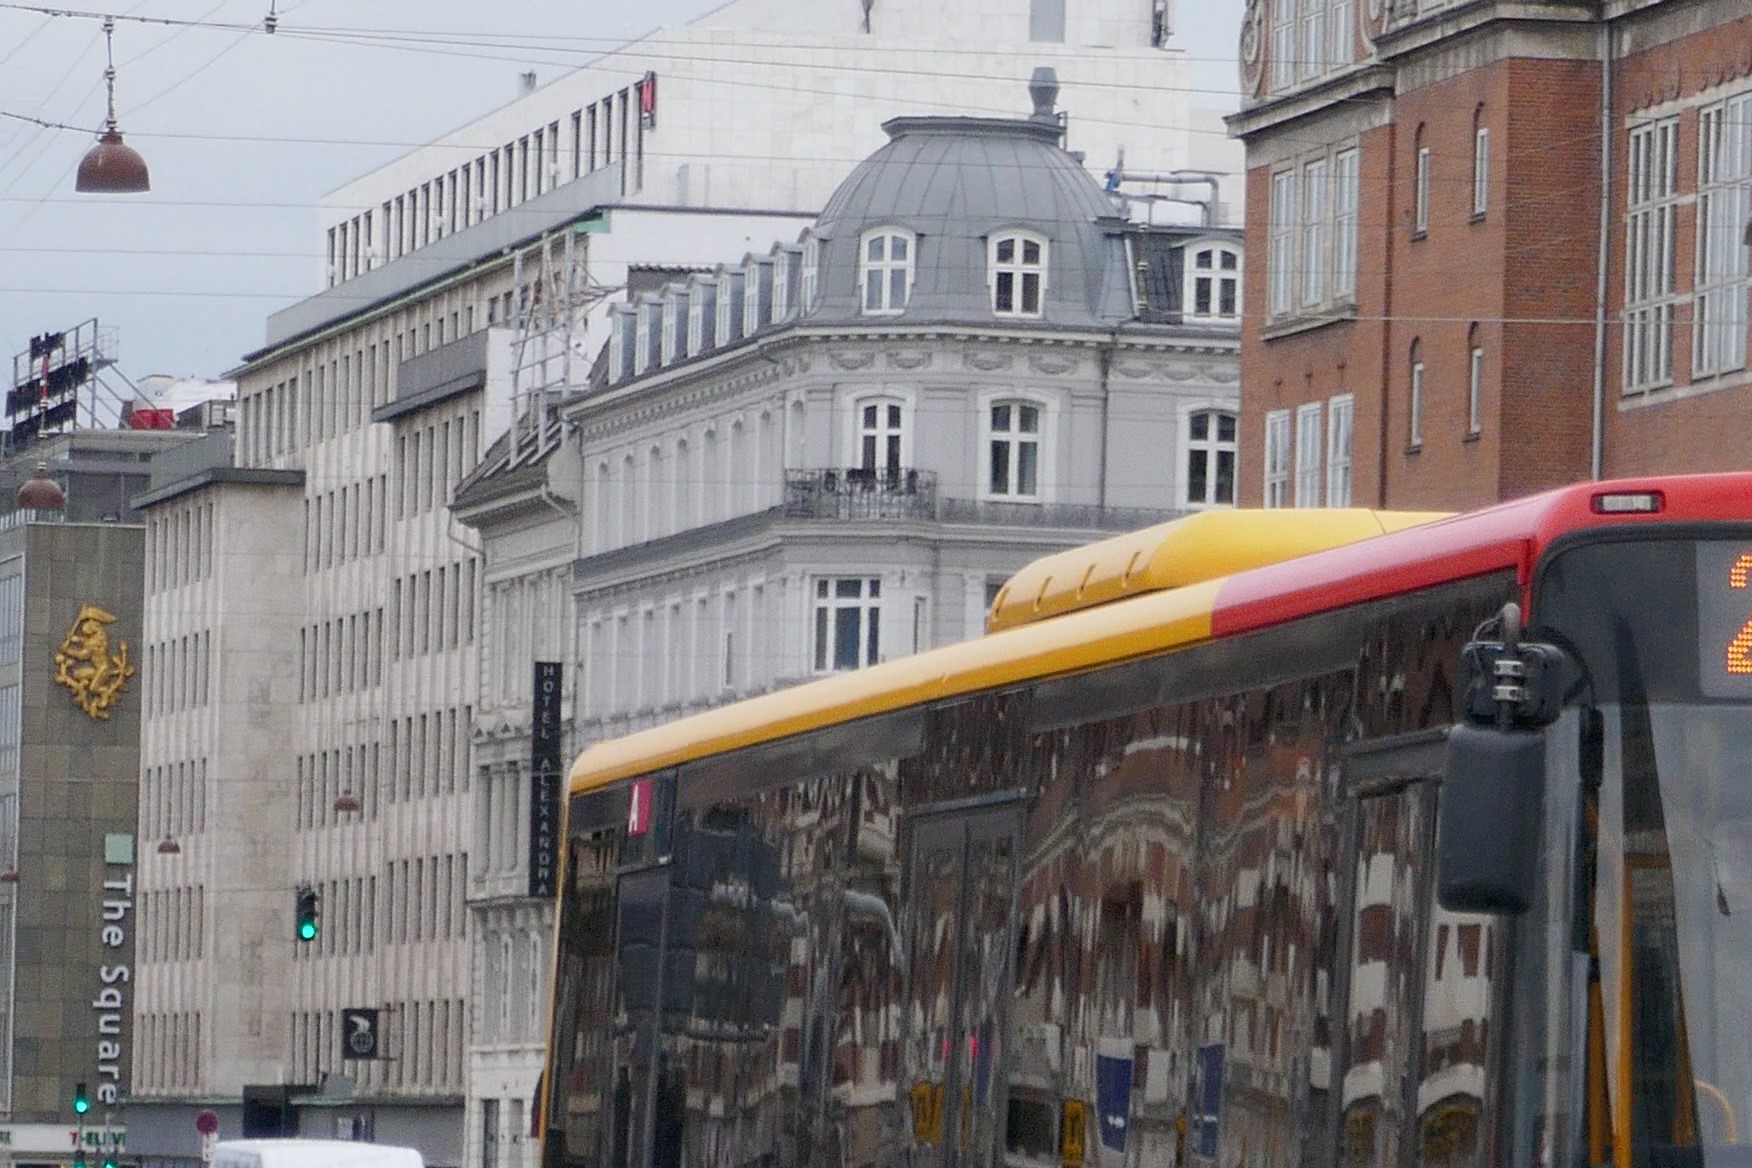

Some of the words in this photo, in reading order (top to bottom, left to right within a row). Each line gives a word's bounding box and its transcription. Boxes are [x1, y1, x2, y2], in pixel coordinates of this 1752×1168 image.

[541, 663, 554, 741] HOTEL
[537, 758, 550, 897] ALEXANDRA
[102, 873, 132, 947] The
[92, 964, 130, 1105] Square
